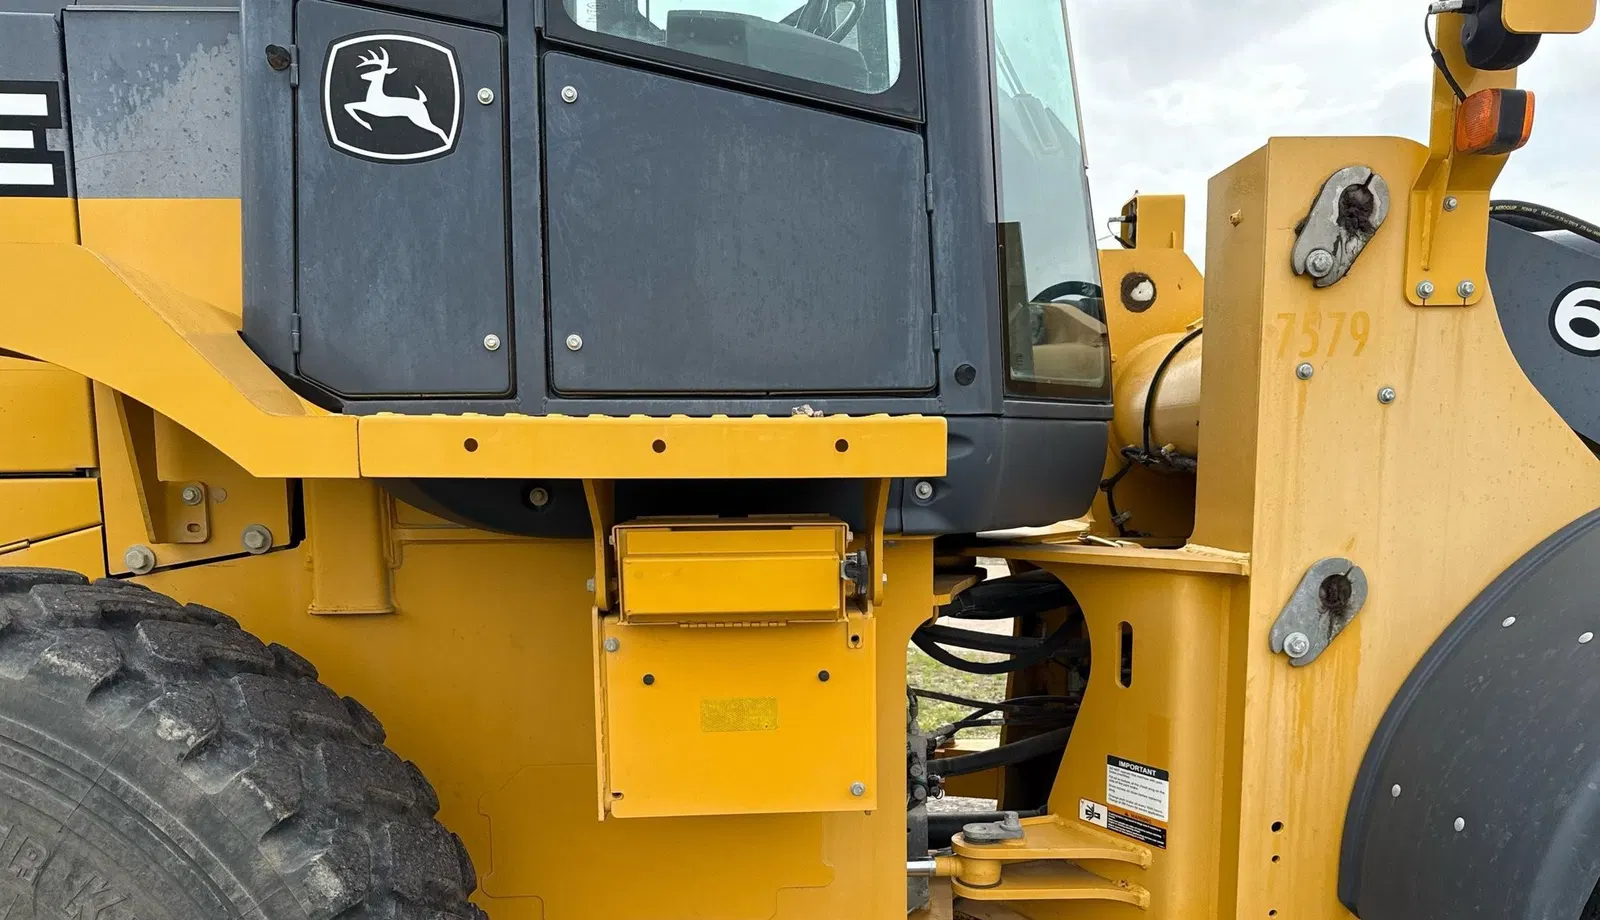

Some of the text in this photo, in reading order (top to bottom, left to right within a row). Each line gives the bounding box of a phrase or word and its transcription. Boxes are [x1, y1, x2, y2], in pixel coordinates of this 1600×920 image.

[1276, 310, 1370, 360] 7579
[1554, 286, 1600, 351] 6
[1118, 760, 1157, 777] IMPORTANT
